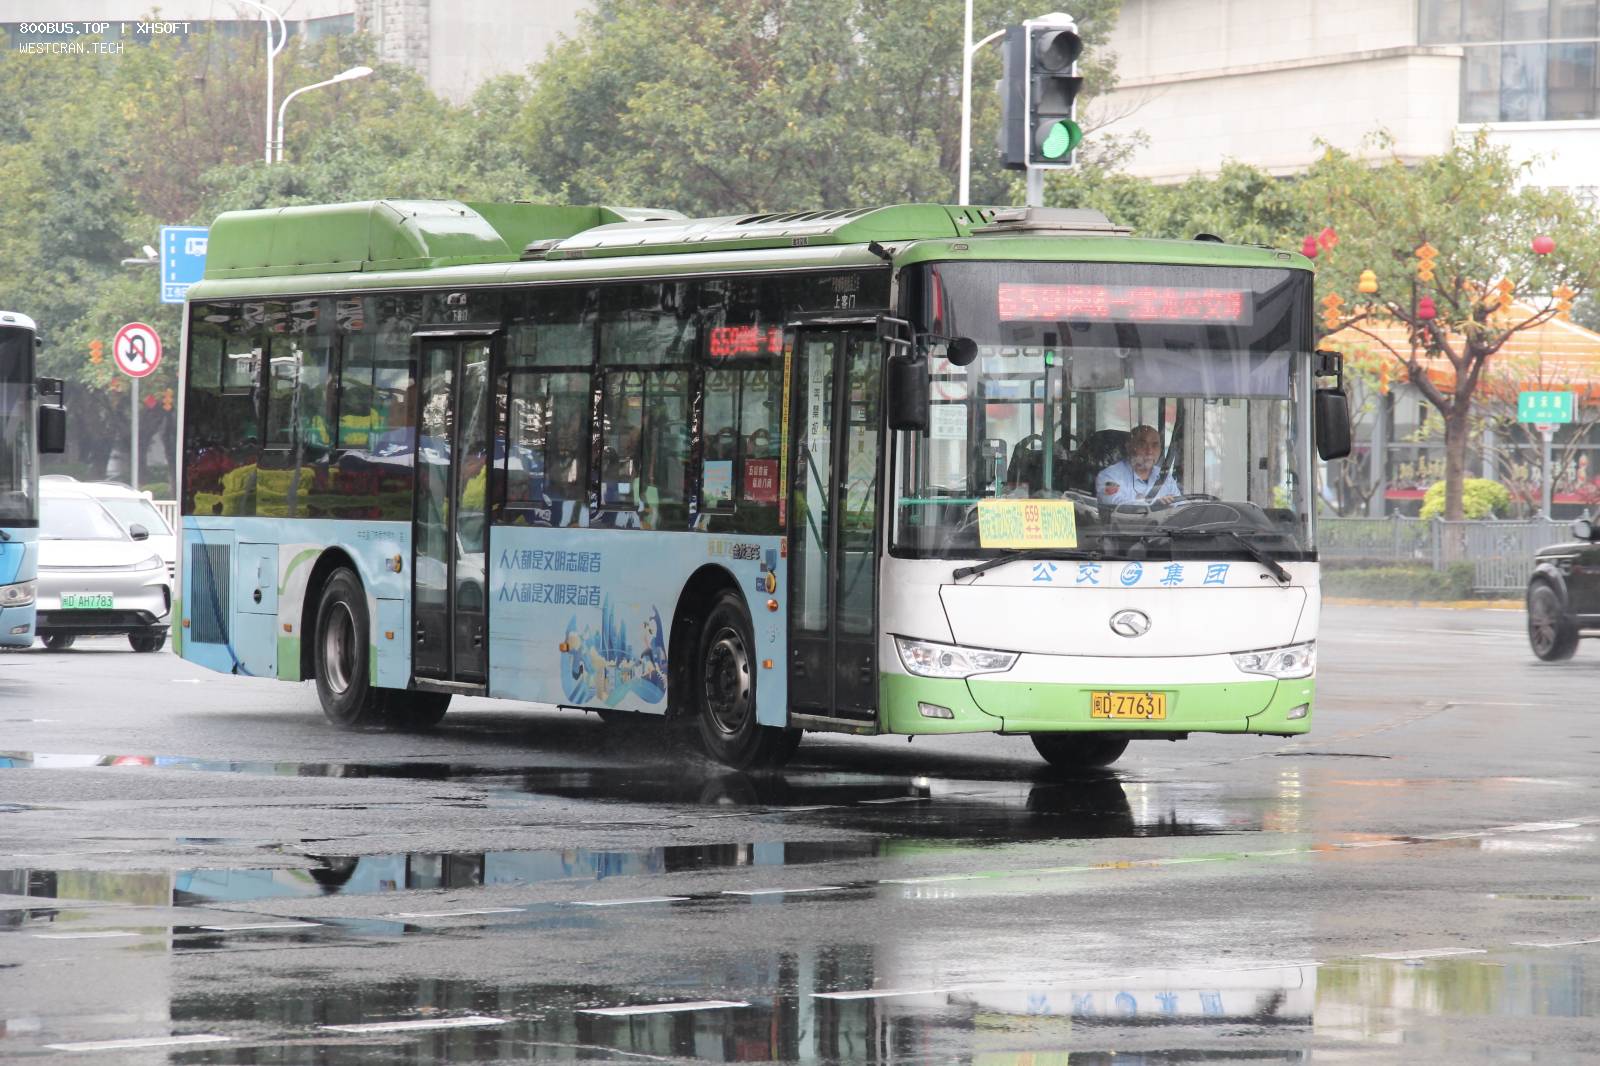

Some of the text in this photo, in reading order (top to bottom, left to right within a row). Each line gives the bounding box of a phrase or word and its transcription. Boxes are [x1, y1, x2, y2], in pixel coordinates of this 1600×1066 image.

[834, 294, 856, 309] 上客门
[1024, 504, 1039, 522] 659
[500, 549, 601, 573] 人人都是文明志愿者
[1032, 562, 1229, 585] 公交 集团
[499, 582, 601, 606] 人人都是文明受益者
